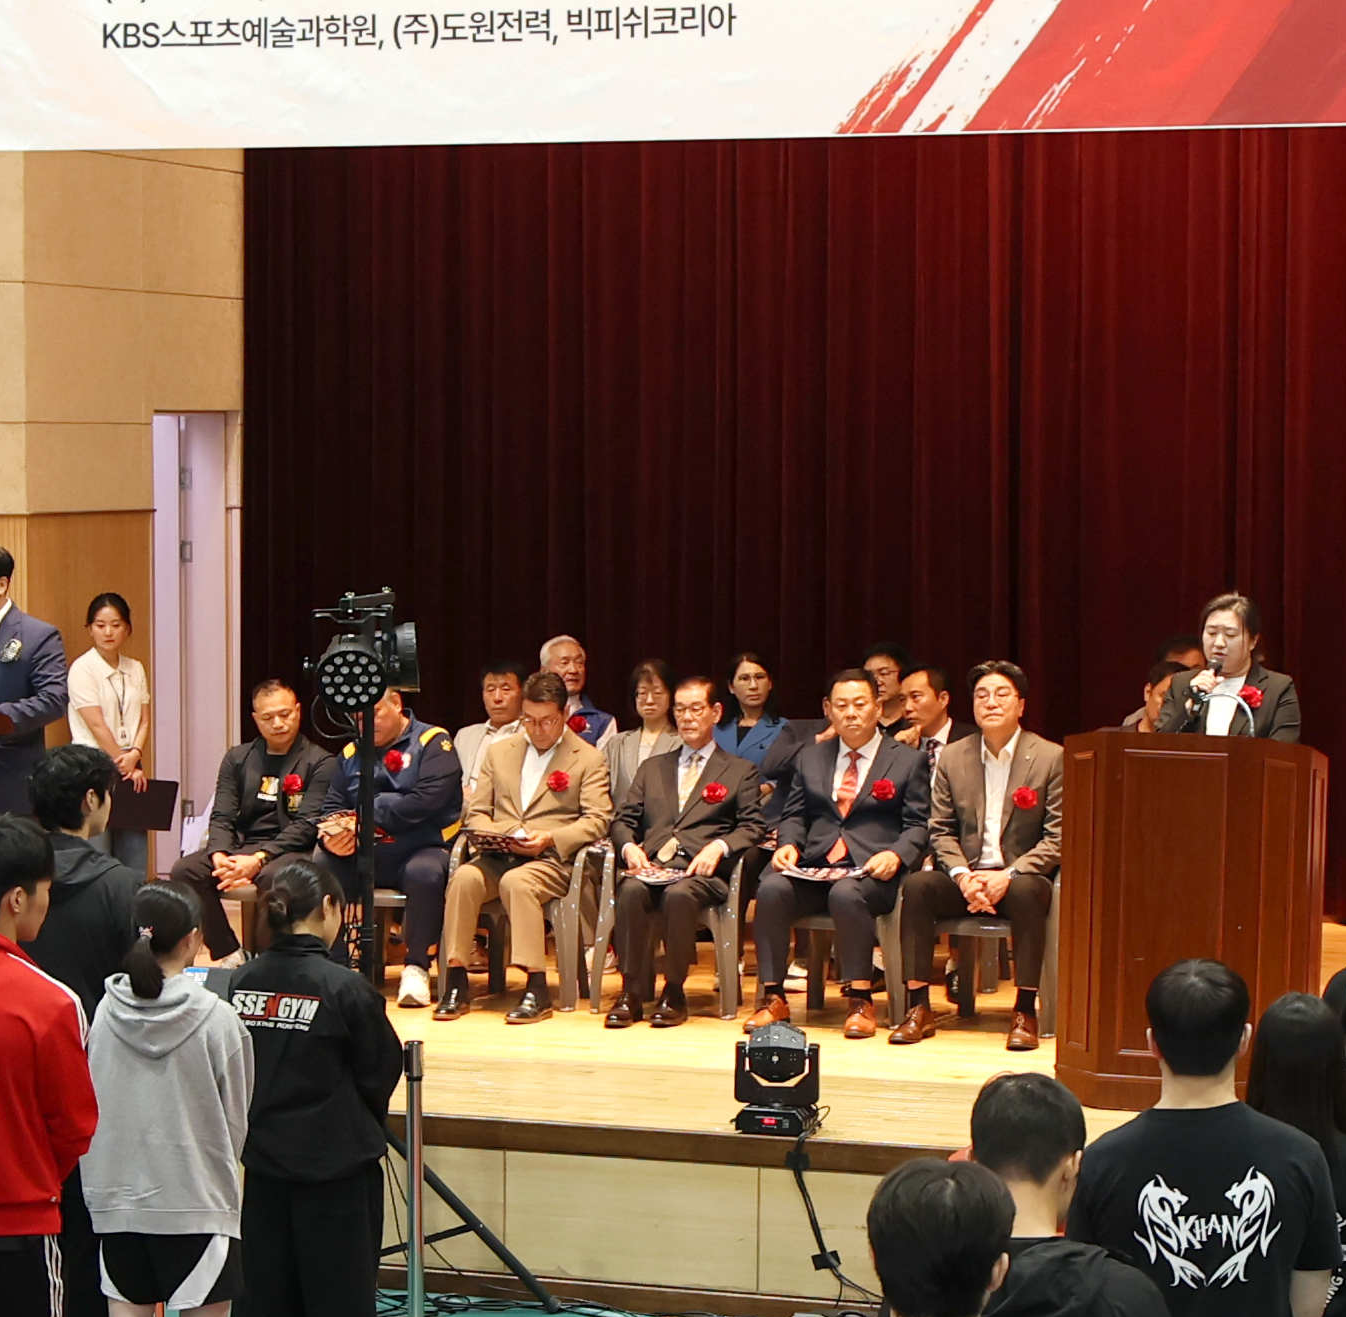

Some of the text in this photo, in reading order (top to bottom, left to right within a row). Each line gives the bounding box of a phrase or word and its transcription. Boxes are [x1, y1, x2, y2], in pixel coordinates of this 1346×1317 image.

[102, 3, 737, 50] KBS스포츠예술과학원, (주)도원전력, 빅피쉬코리아
